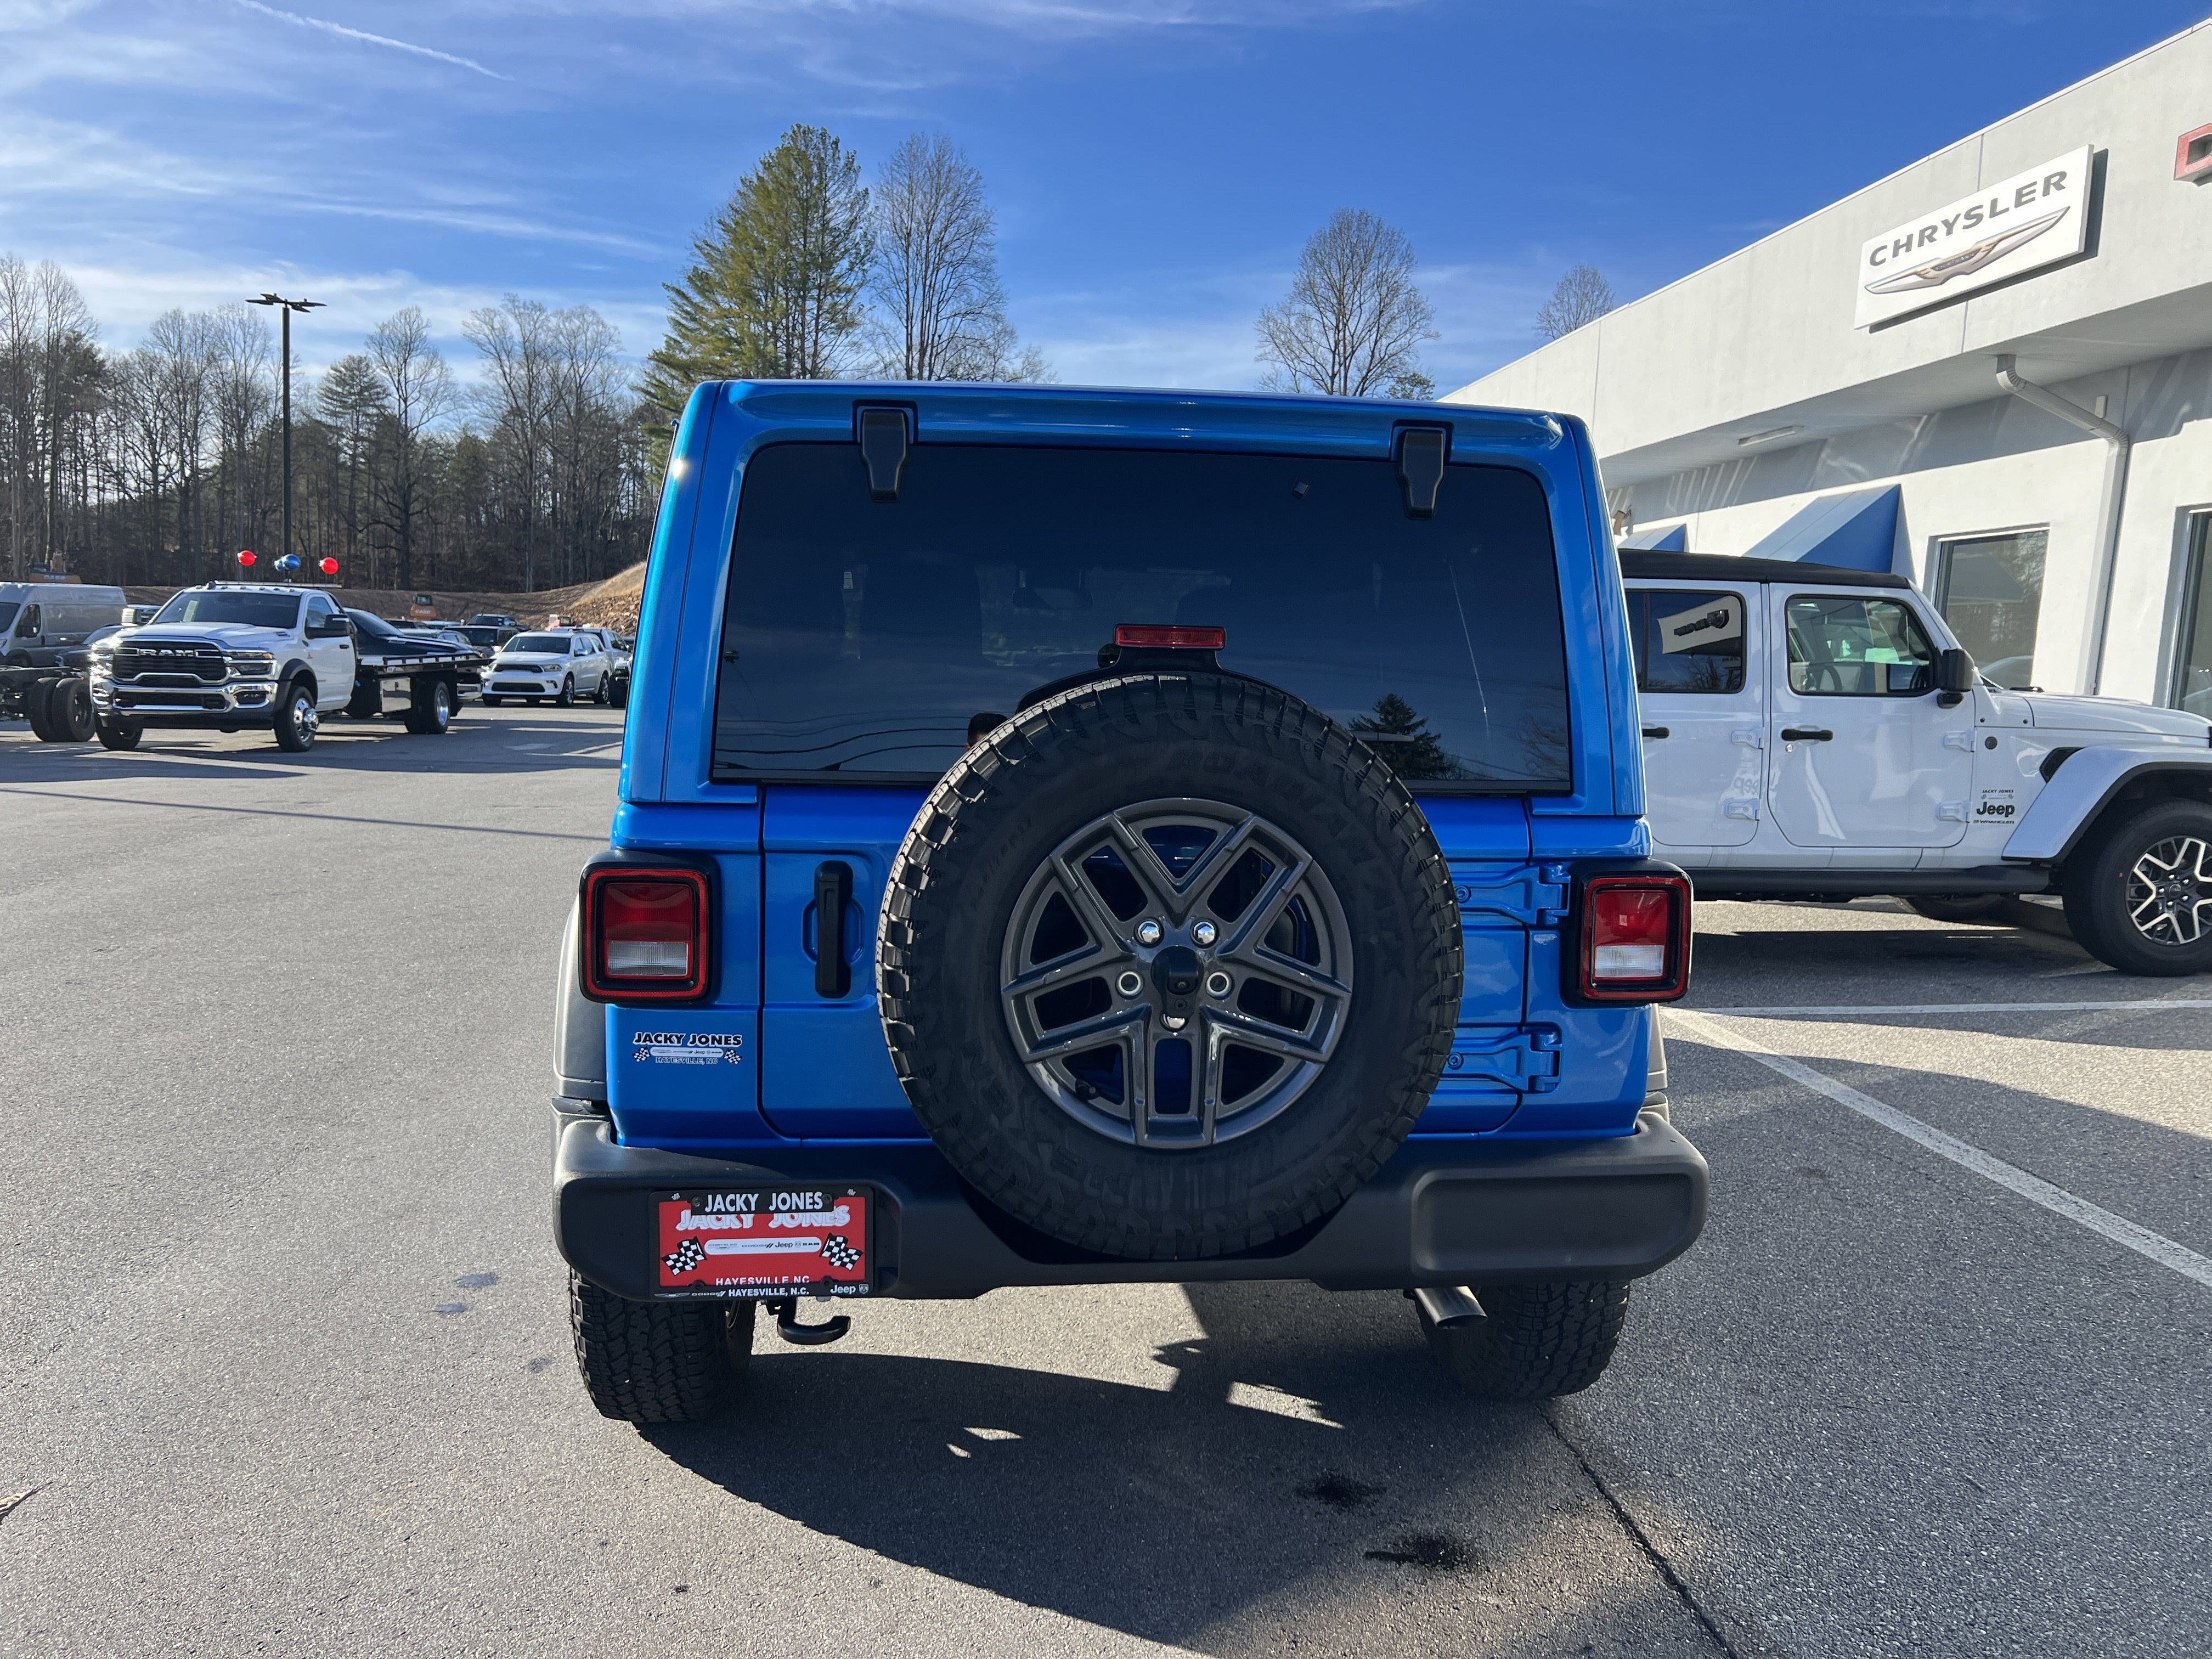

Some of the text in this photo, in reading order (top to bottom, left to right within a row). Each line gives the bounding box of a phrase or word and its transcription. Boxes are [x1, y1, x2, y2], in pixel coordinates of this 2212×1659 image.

[1869, 171, 2068, 267] CHRYSLER
[139, 648, 194, 657] RAM
[1976, 802, 2015, 818] Jeep
[633, 1032, 743, 1047] JACKY JONES
[656, 1057, 704, 1065] HAYESVILLE,
[705, 1192, 823, 1212] JACKY JONES
[675, 1205, 851, 1231] JACKY JONES
[793, 1275, 810, 1284] NC
[728, 1286, 809, 1297] HAYESVILLE, N.C.
[830, 1284, 856, 1295] Jeep
